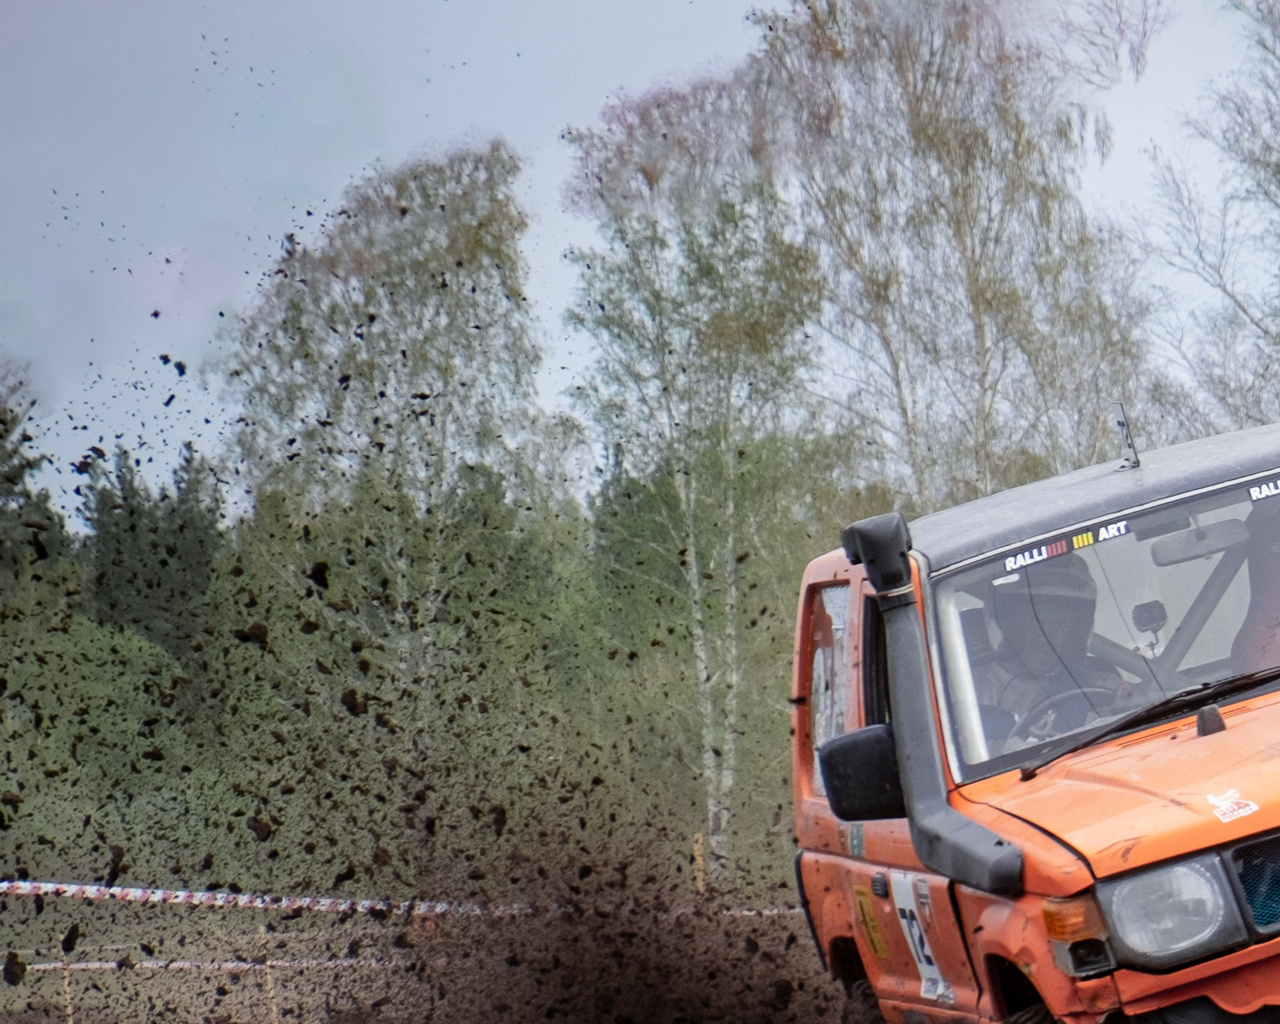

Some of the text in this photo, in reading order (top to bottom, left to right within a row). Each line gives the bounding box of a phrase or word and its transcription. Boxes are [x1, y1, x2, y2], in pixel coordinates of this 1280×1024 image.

[1004, 520, 1128, 572] RALLI ART
[899, 908, 935, 966] 72
